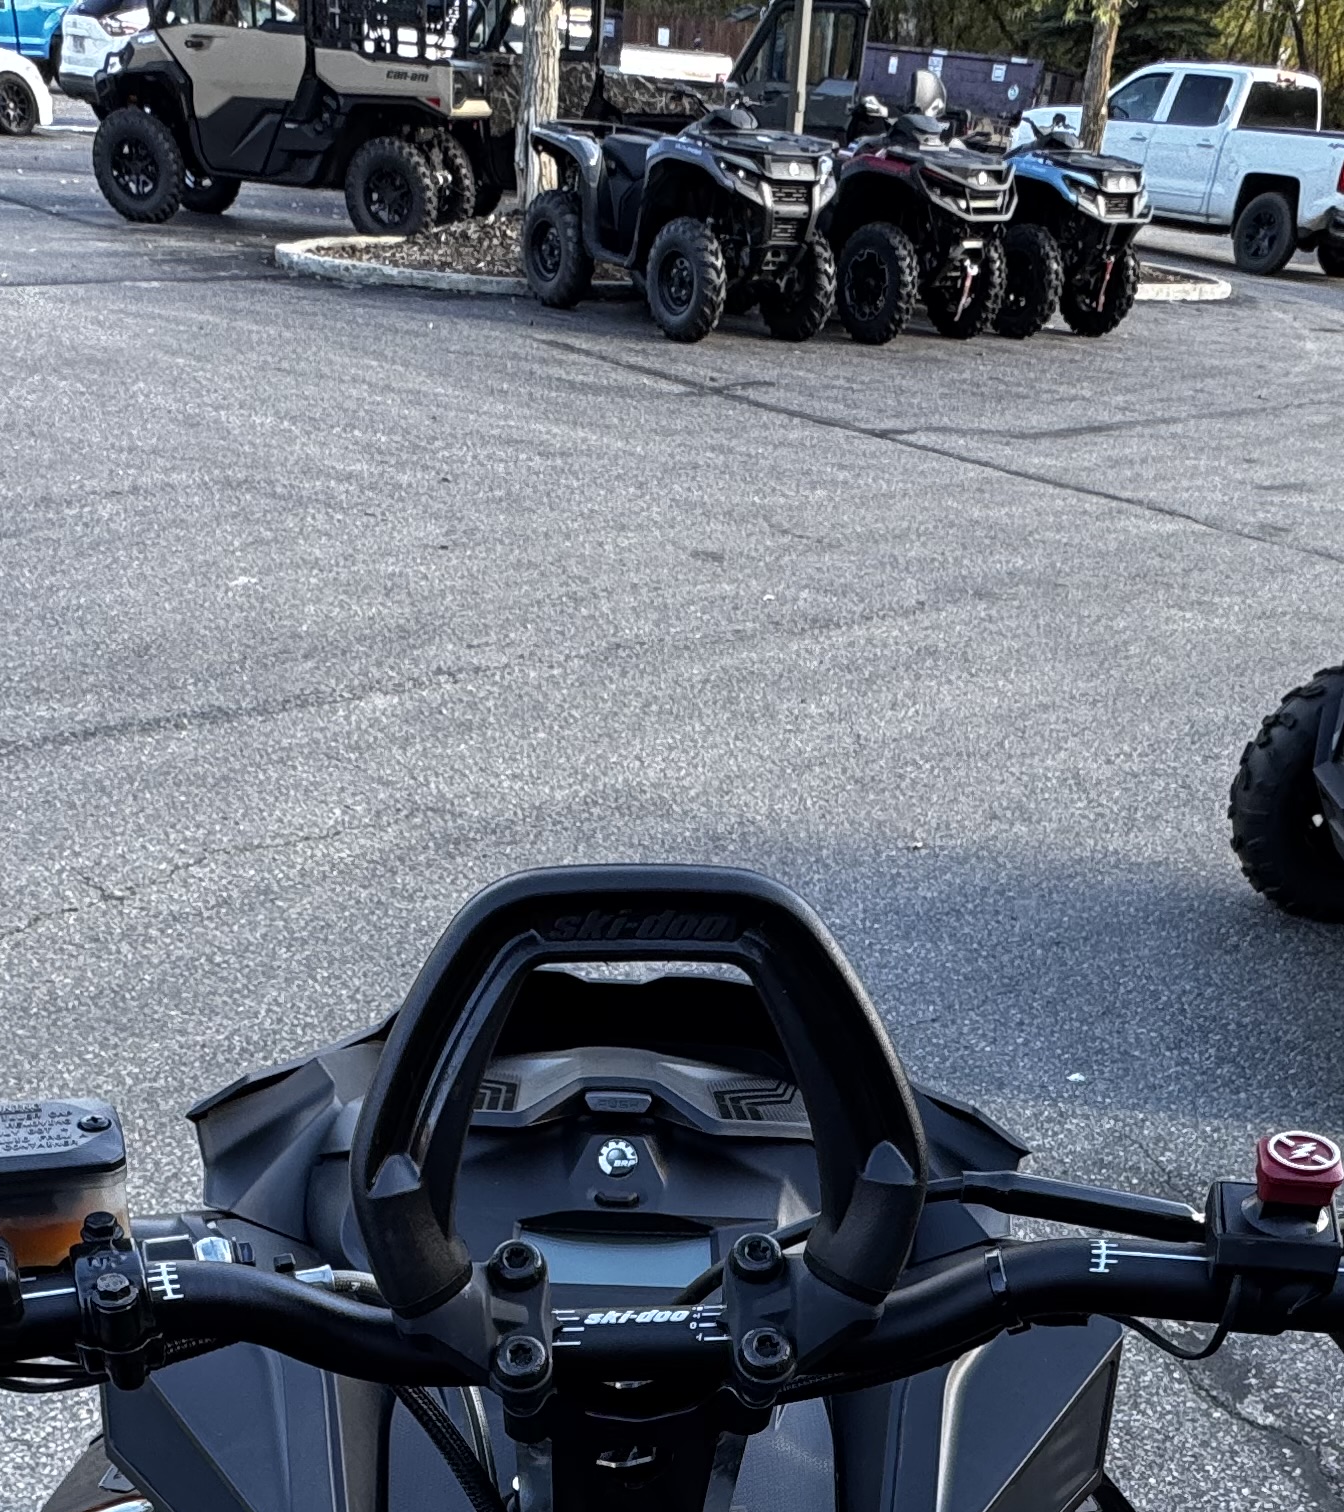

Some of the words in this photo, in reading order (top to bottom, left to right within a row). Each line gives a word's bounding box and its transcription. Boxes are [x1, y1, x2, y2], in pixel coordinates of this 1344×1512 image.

[549, 909, 737, 940] ski-doo
[613, 1159, 638, 1167] BRP
[583, 1309, 690, 1325] ski-doo
